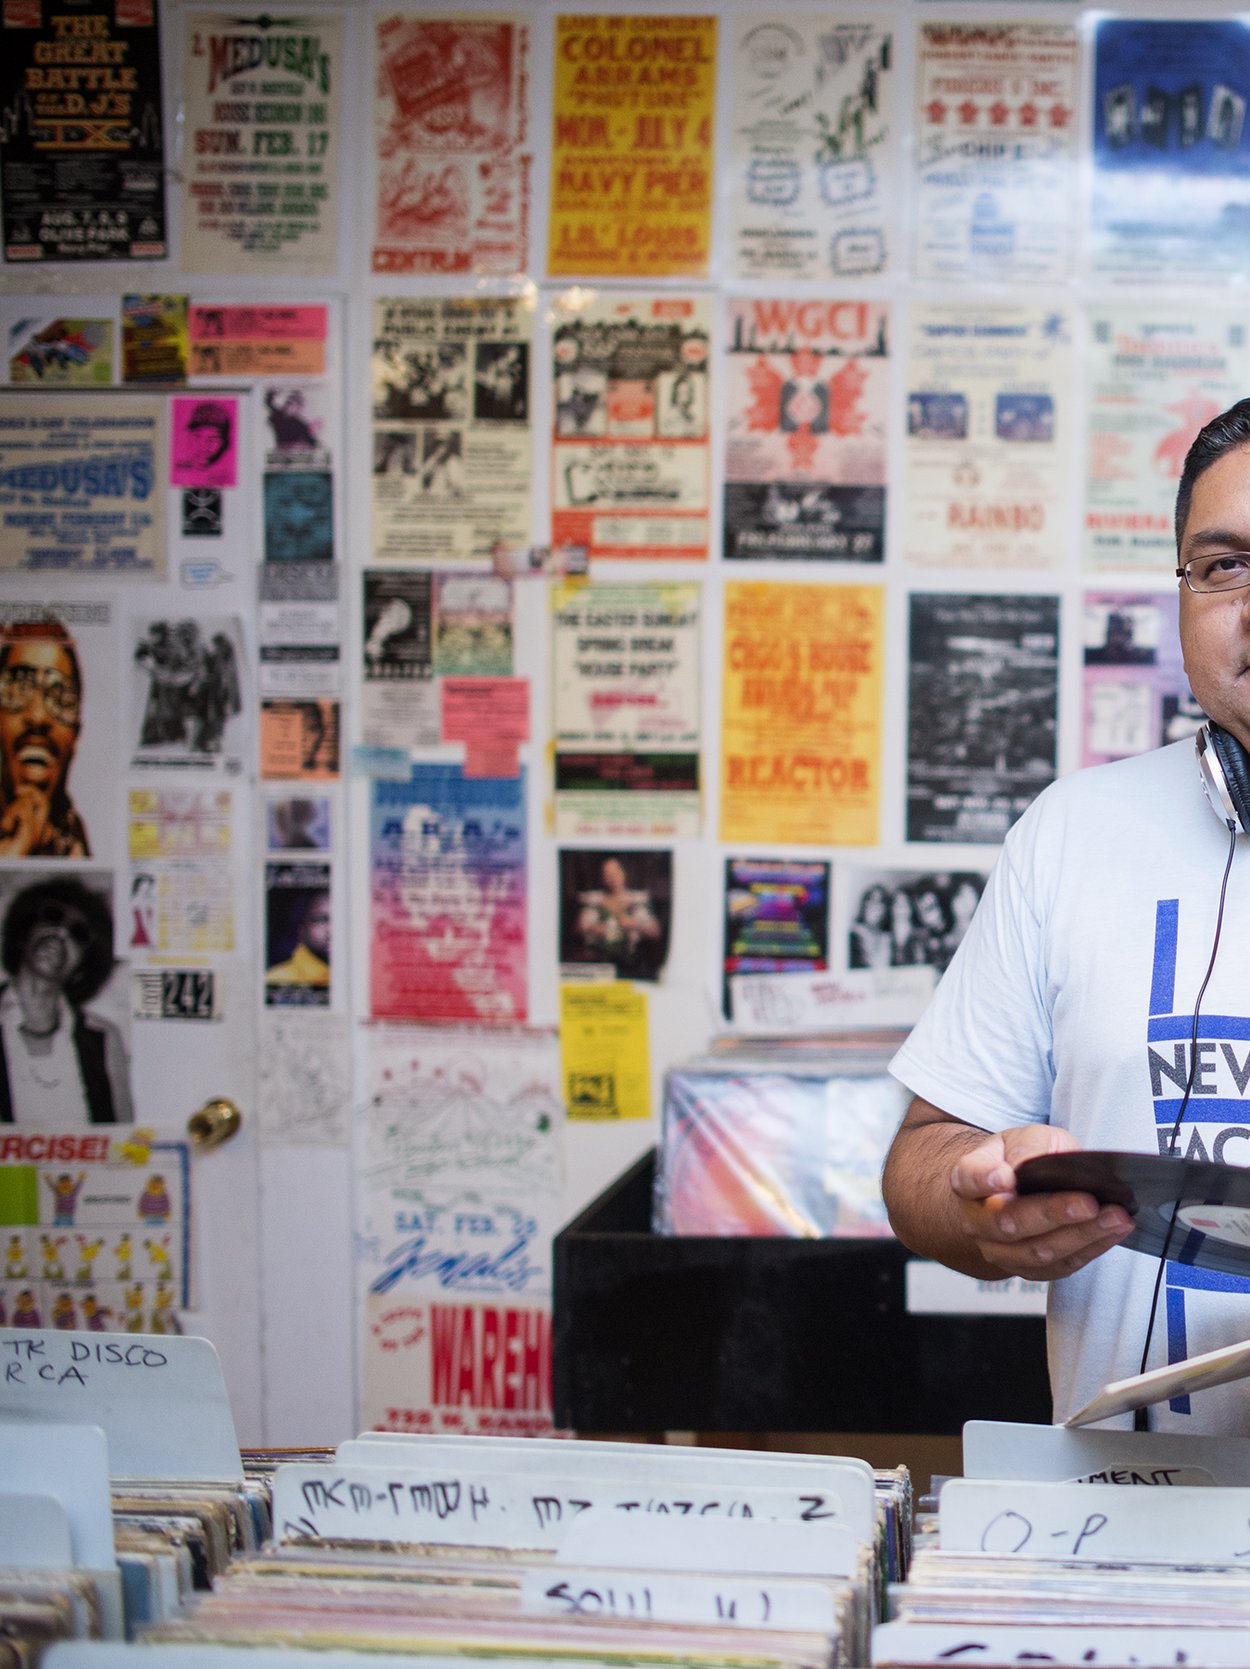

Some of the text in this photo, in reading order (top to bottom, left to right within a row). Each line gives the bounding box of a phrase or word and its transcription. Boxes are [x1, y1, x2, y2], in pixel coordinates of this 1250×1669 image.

[51, 15, 110, 36] THE
[34, 41, 128, 63] GREAT
[562, 34, 710, 64] COLONEL
[25, 68, 138, 89] BATTLE
[574, 66, 698, 86] ABRAMS
[195, 129, 330, 156] SUN. FEB. 17
[557, 170, 709, 195] NAVY PIER
[754, 300, 867, 338] WGCI
[944, 502, 1043, 532] RAINBO
[727, 756, 870, 792] REACTOR
[164, 974, 212, 1014] 242
[0, 1135, 110, 1161] RCISE!
[395, 1211, 442, 1234] SAT.
[455, 1213, 500, 1235] FEB.
[3, 1340, 168, 1367] TK DISCO
[1088, 1470, 1182, 1486] MENT
